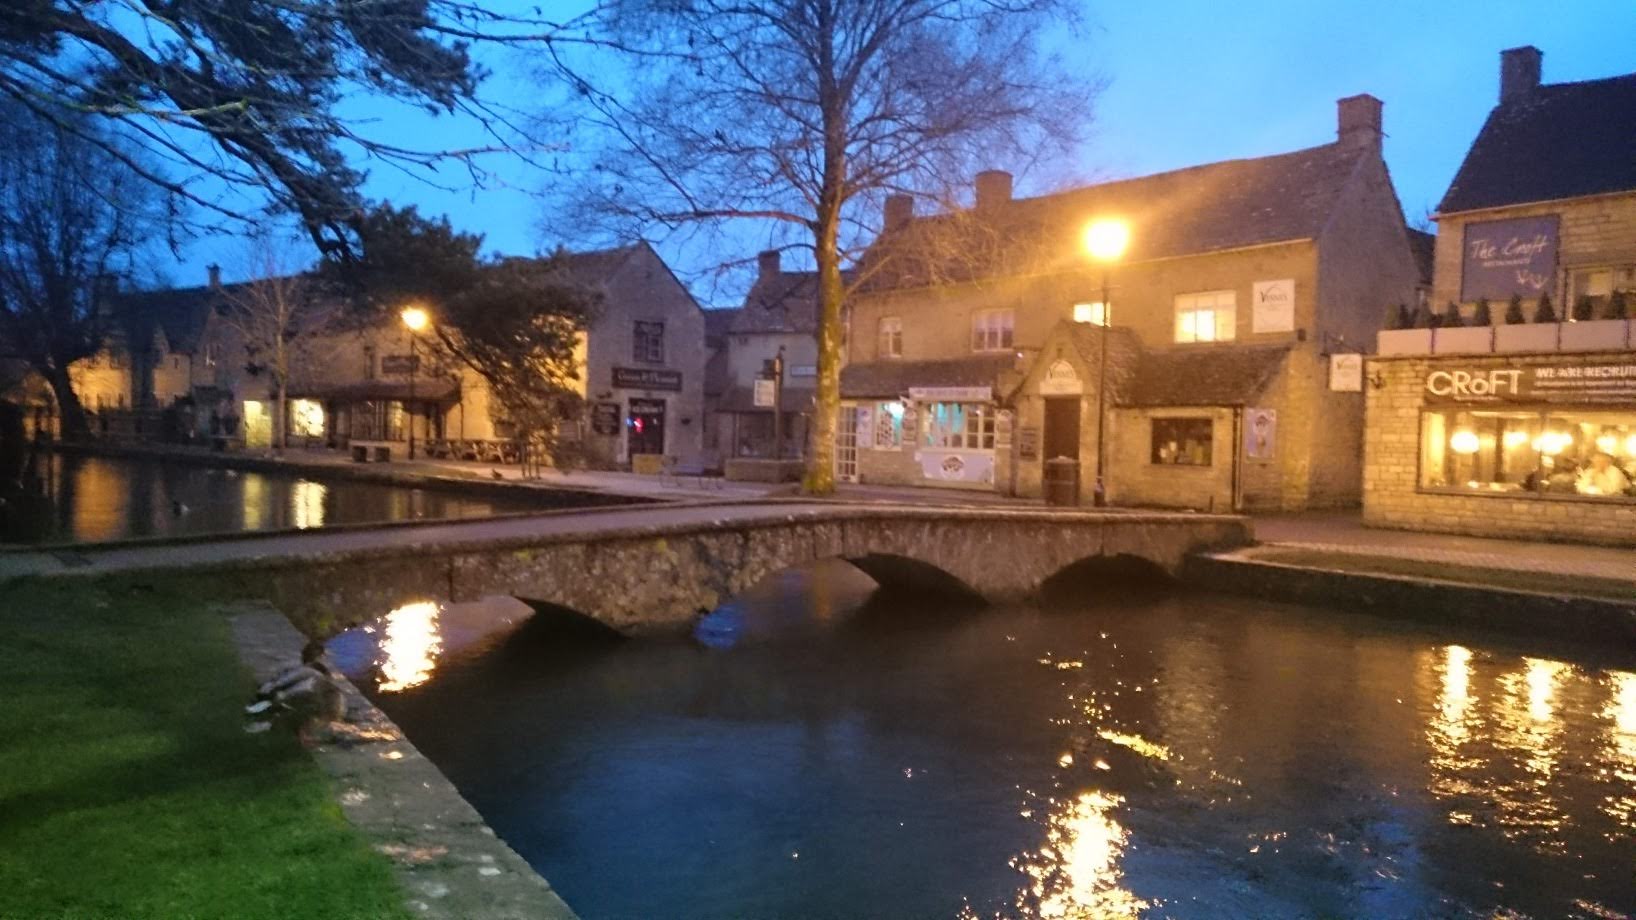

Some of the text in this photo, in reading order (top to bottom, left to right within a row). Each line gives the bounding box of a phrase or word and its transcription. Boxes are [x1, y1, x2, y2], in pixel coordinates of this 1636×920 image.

[1471, 234, 1549, 260] The Croft
[1535, 367, 1555, 378] WE
[1557, 367, 1583, 378] ARE
